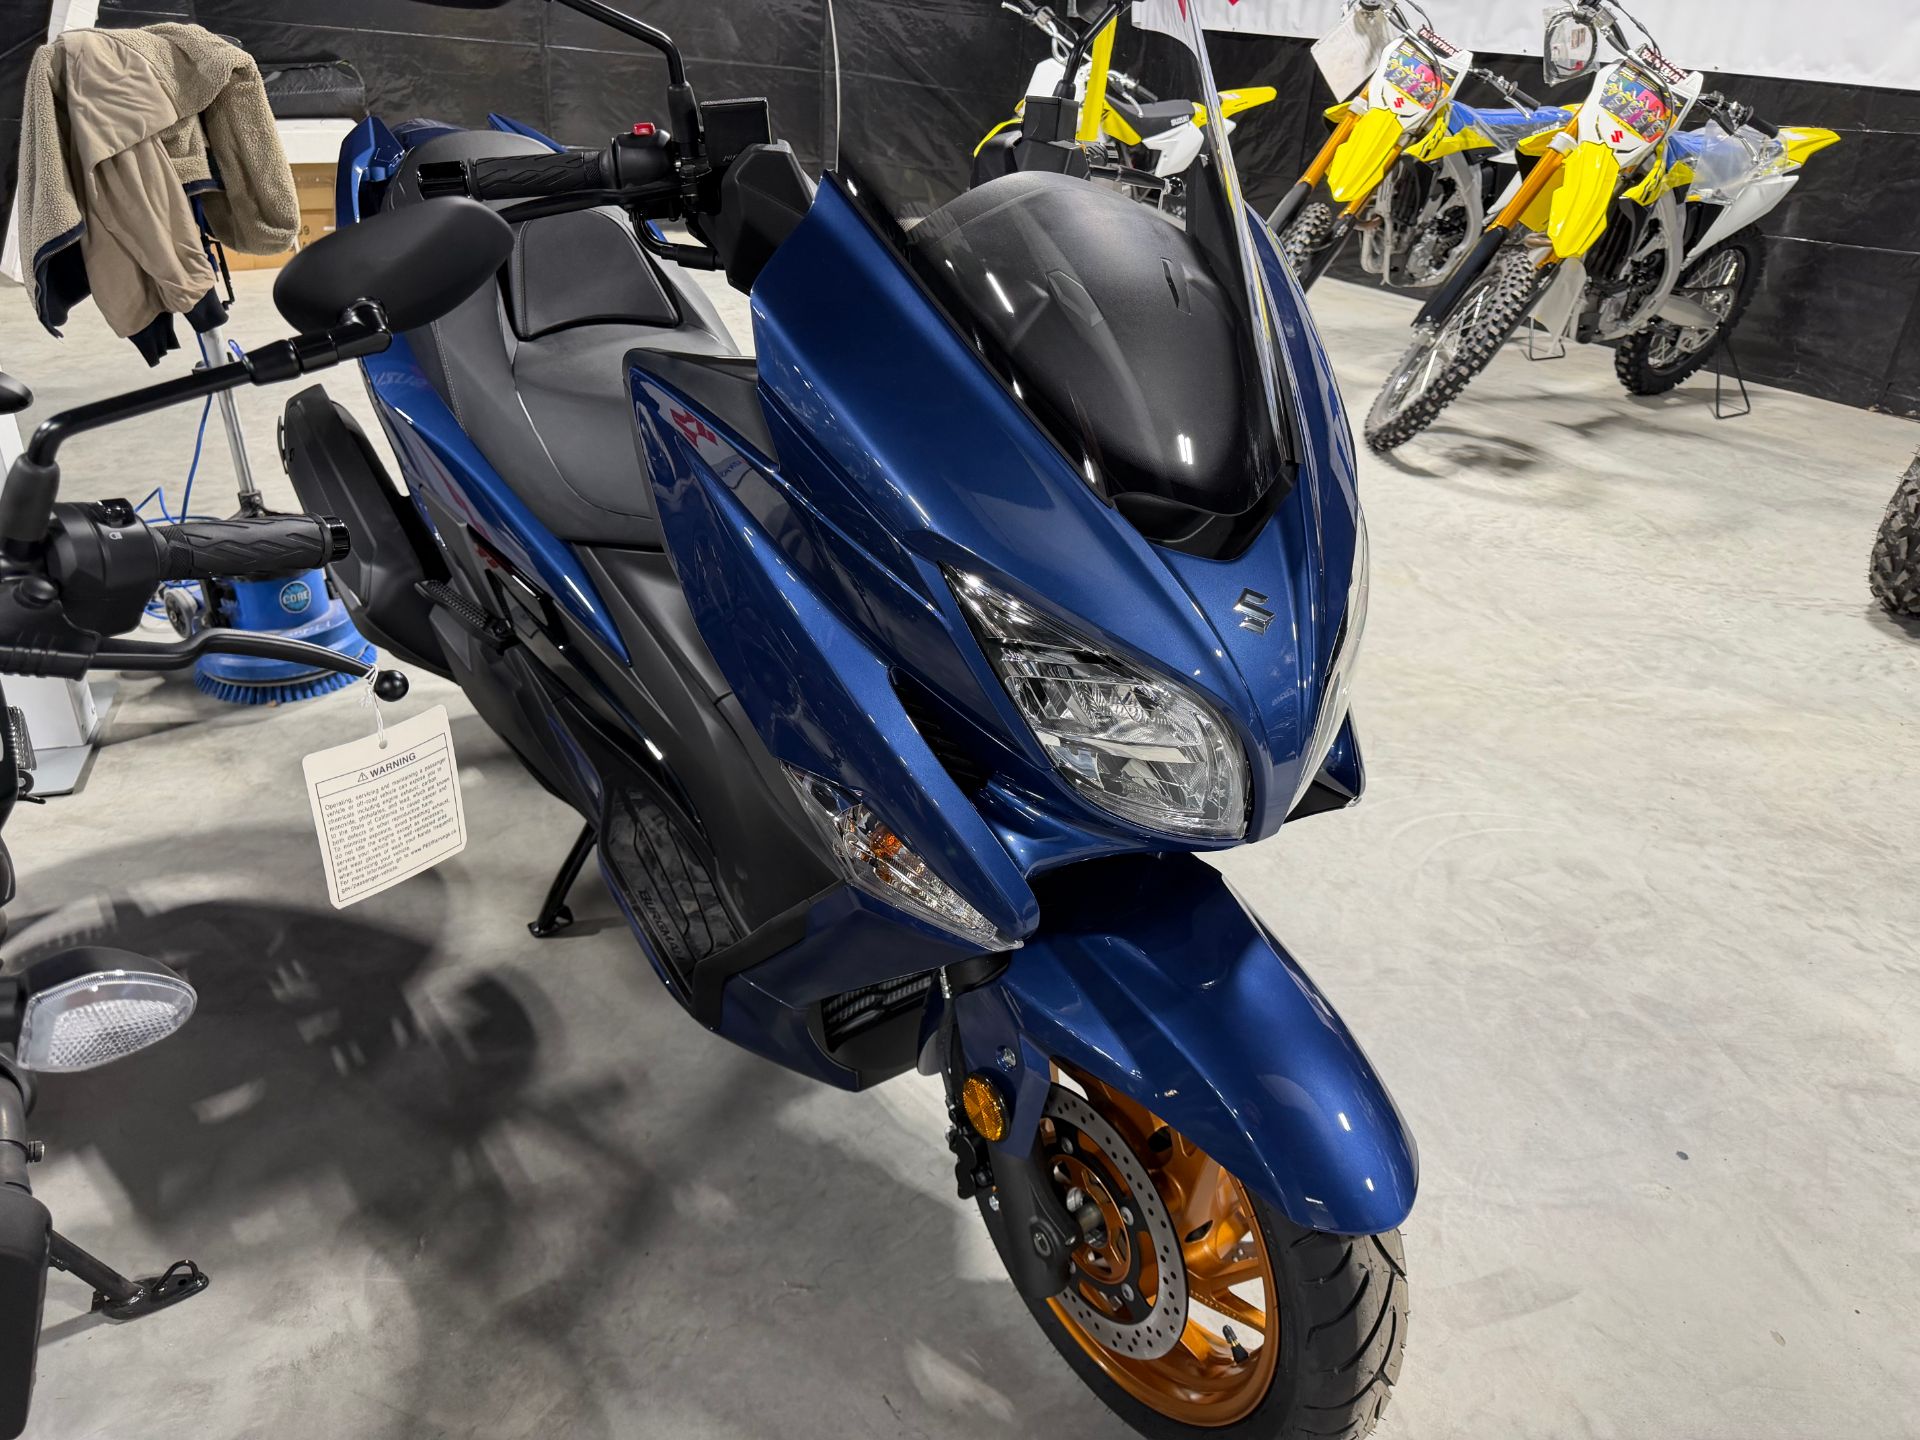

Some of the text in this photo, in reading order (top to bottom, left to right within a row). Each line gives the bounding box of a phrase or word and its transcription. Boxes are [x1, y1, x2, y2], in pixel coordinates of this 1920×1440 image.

[282, 590, 309, 605] CORE
[369, 752, 417, 778] WARNING
[638, 889, 684, 961] BURGMAN
